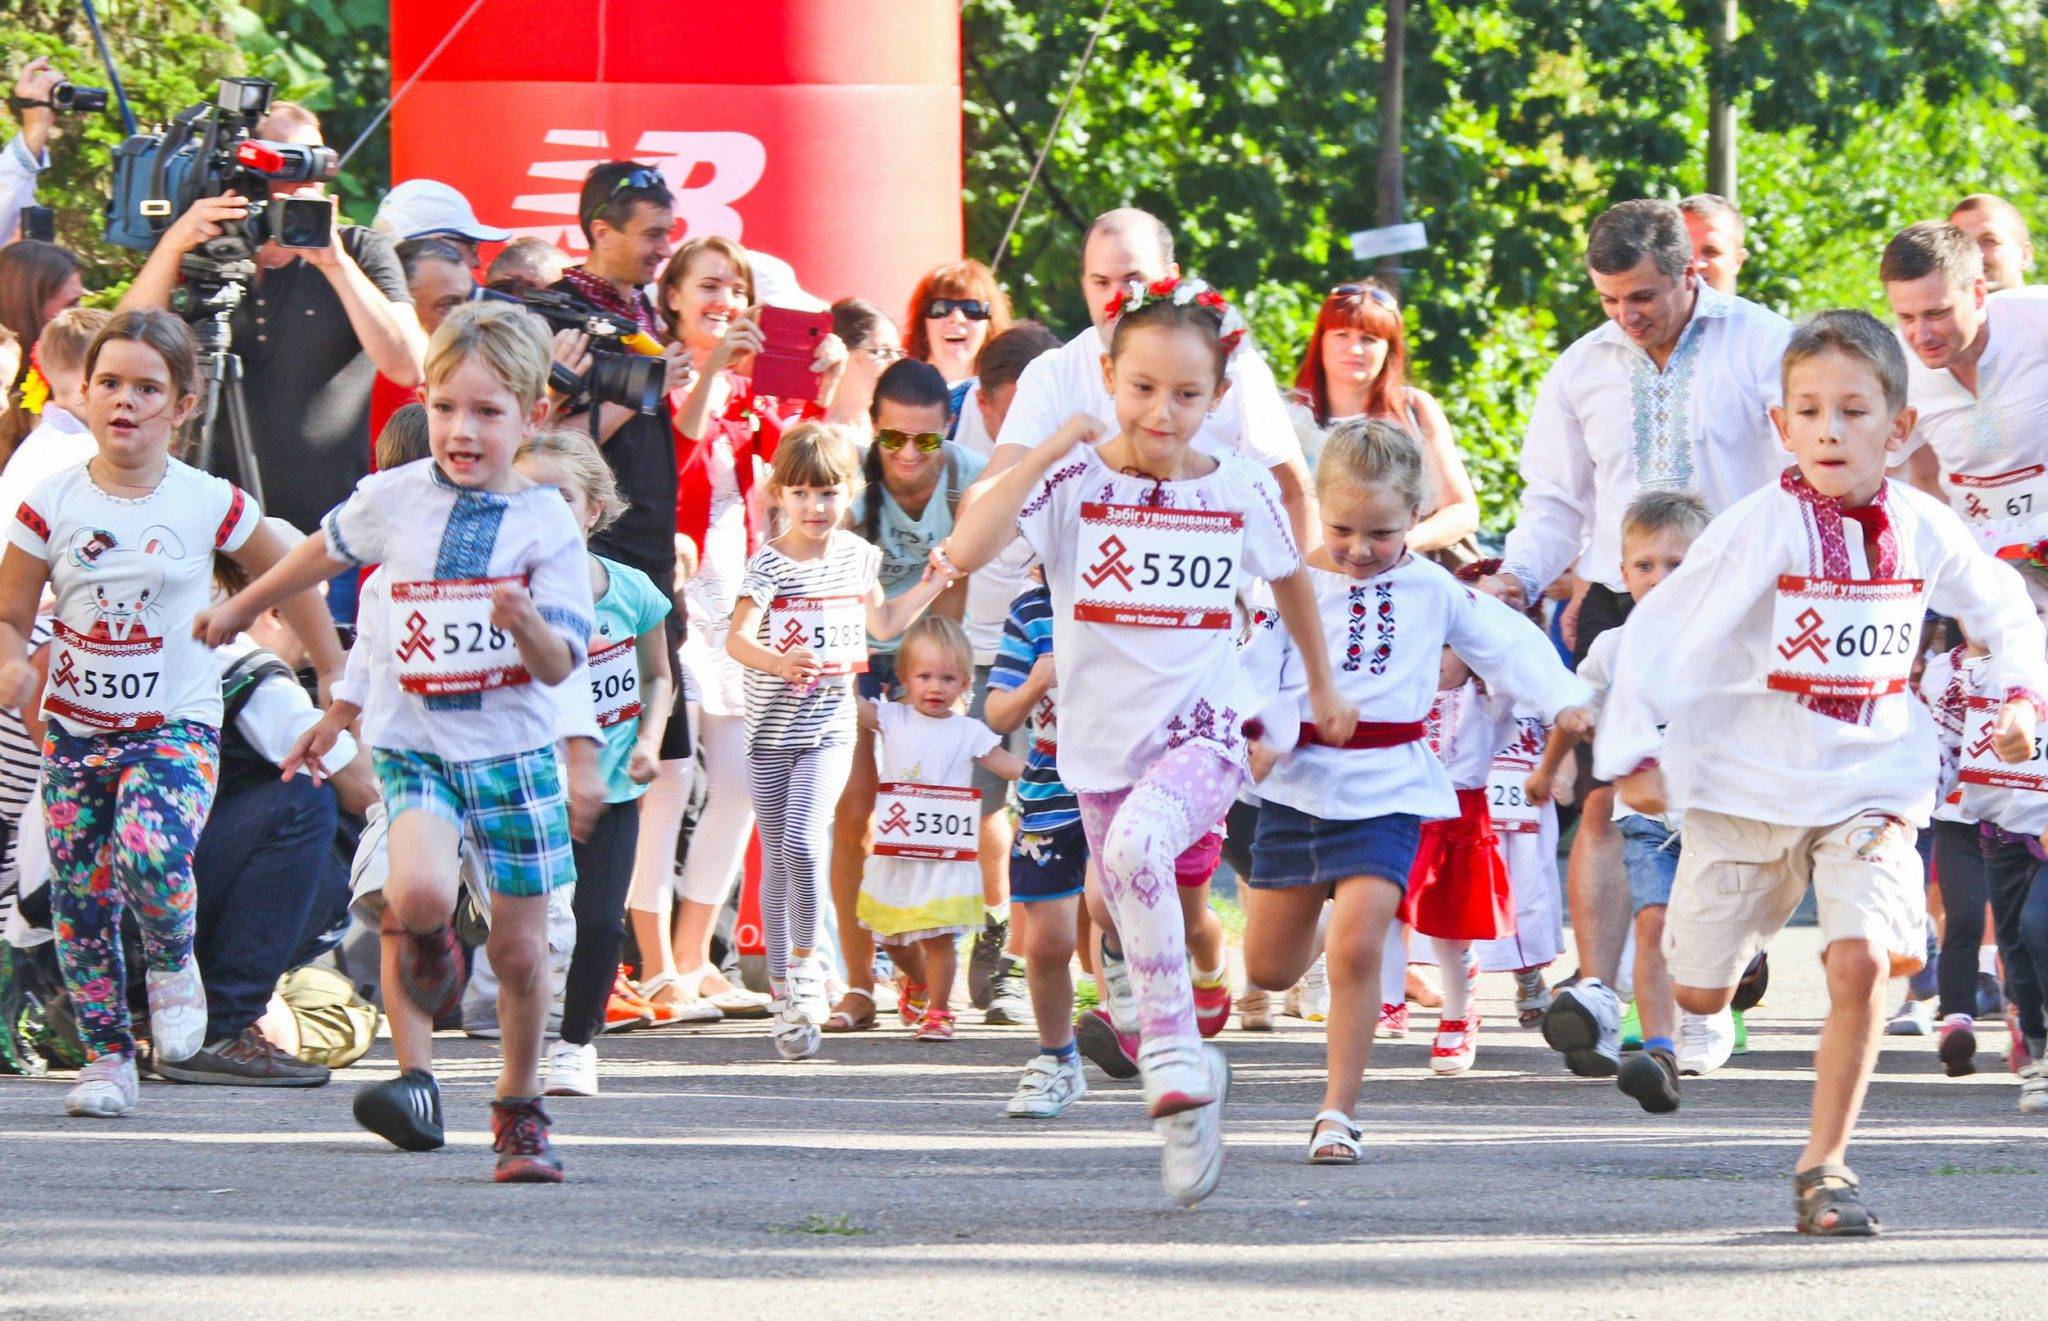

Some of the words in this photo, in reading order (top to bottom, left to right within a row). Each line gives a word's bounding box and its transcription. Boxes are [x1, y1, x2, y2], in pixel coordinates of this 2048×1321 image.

[1106, 506, 1142, 523] Забіг
[1152, 513, 1232, 527] вишиванках
[1141, 552, 1233, 589] 5302
[443, 622, 516, 654] 528
[814, 624, 861, 648] 5285
[1836, 622, 1912, 657] 6028
[84, 669, 159, 700] 5307
[915, 812, 974, 836] 5301
